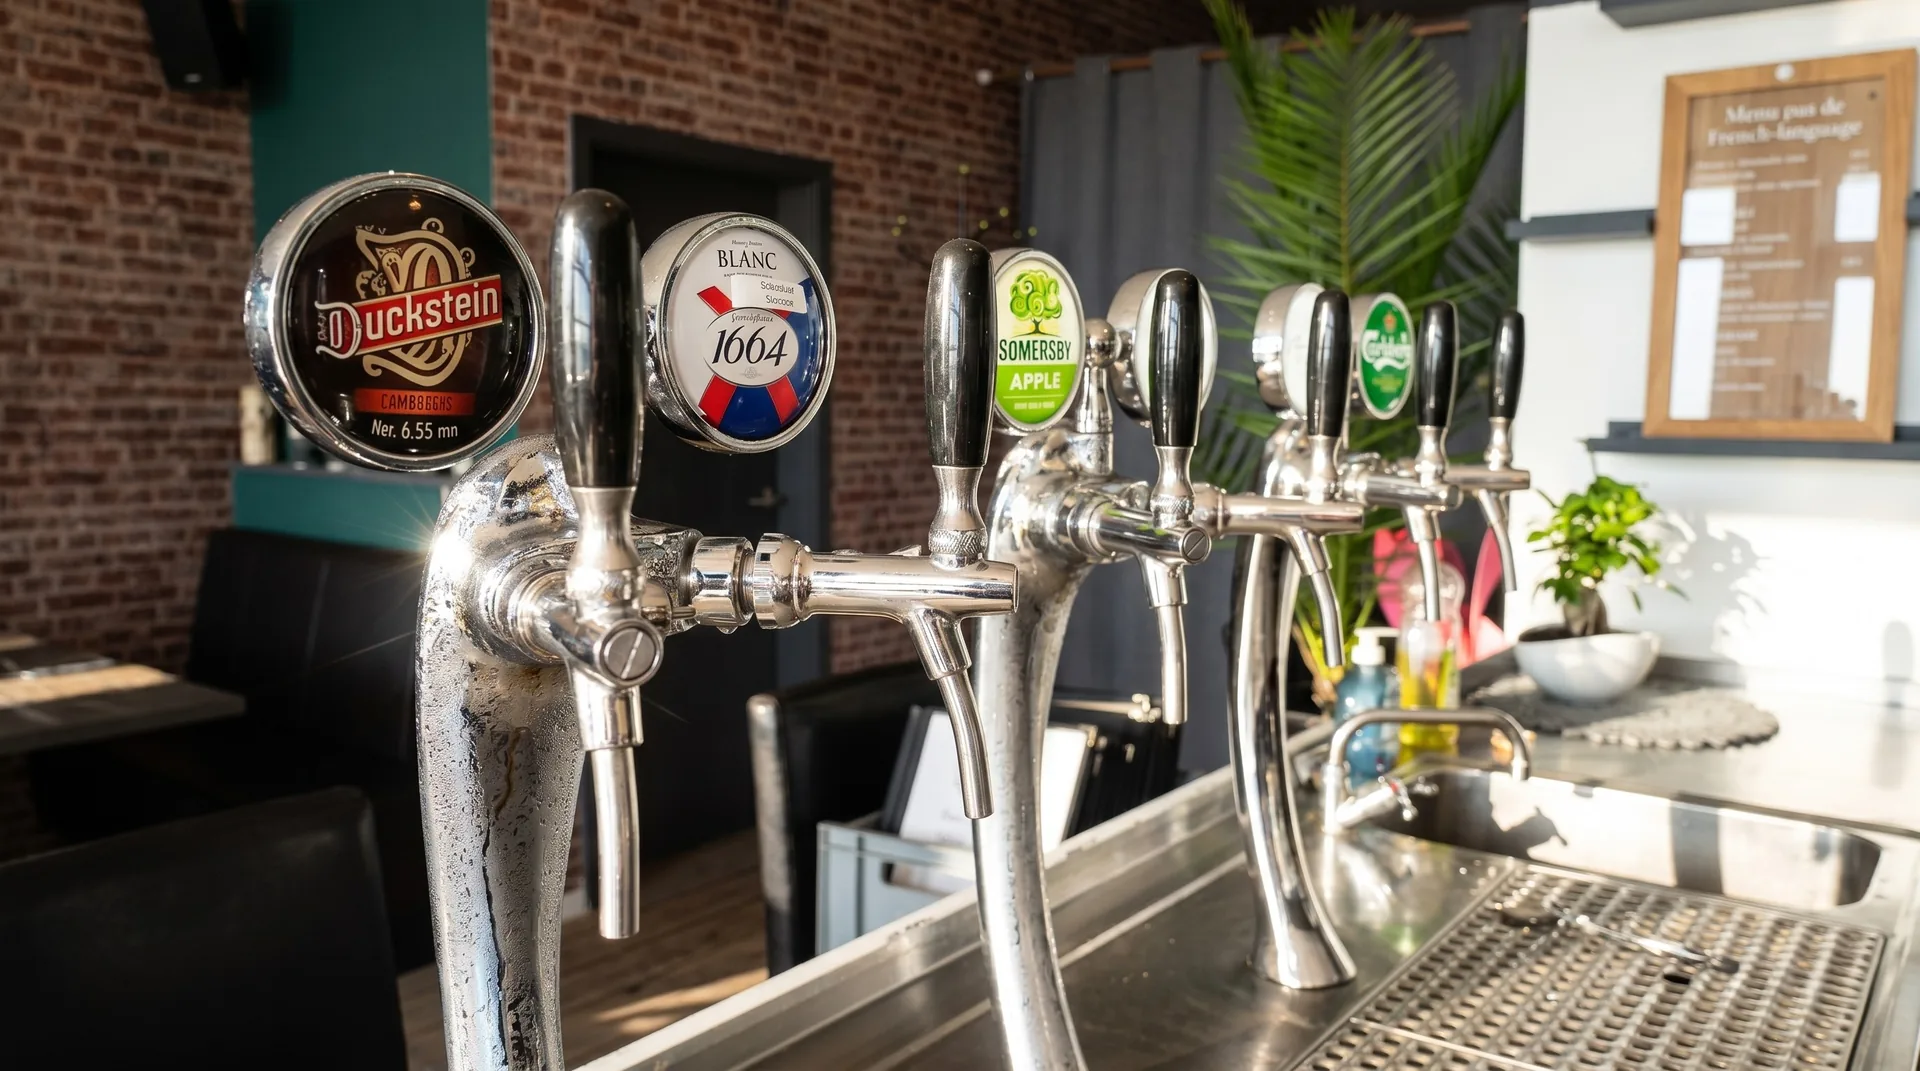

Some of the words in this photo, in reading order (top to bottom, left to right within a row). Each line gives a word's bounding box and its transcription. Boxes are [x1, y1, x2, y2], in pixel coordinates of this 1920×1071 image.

[1725, 105, 1780, 124] Menu
[1820, 97, 1846, 116] de
[717, 249, 777, 270] BLANC
[314, 281, 499, 359] Duckstein
[712, 325, 788, 367] 1664
[999, 339, 1071, 361] SOMERSBY
[1009, 371, 1061, 390] APPLE
[371, 418, 397, 438] Ner.
[401, 421, 433, 440] 6.55
[438, 425, 459, 439] mn
